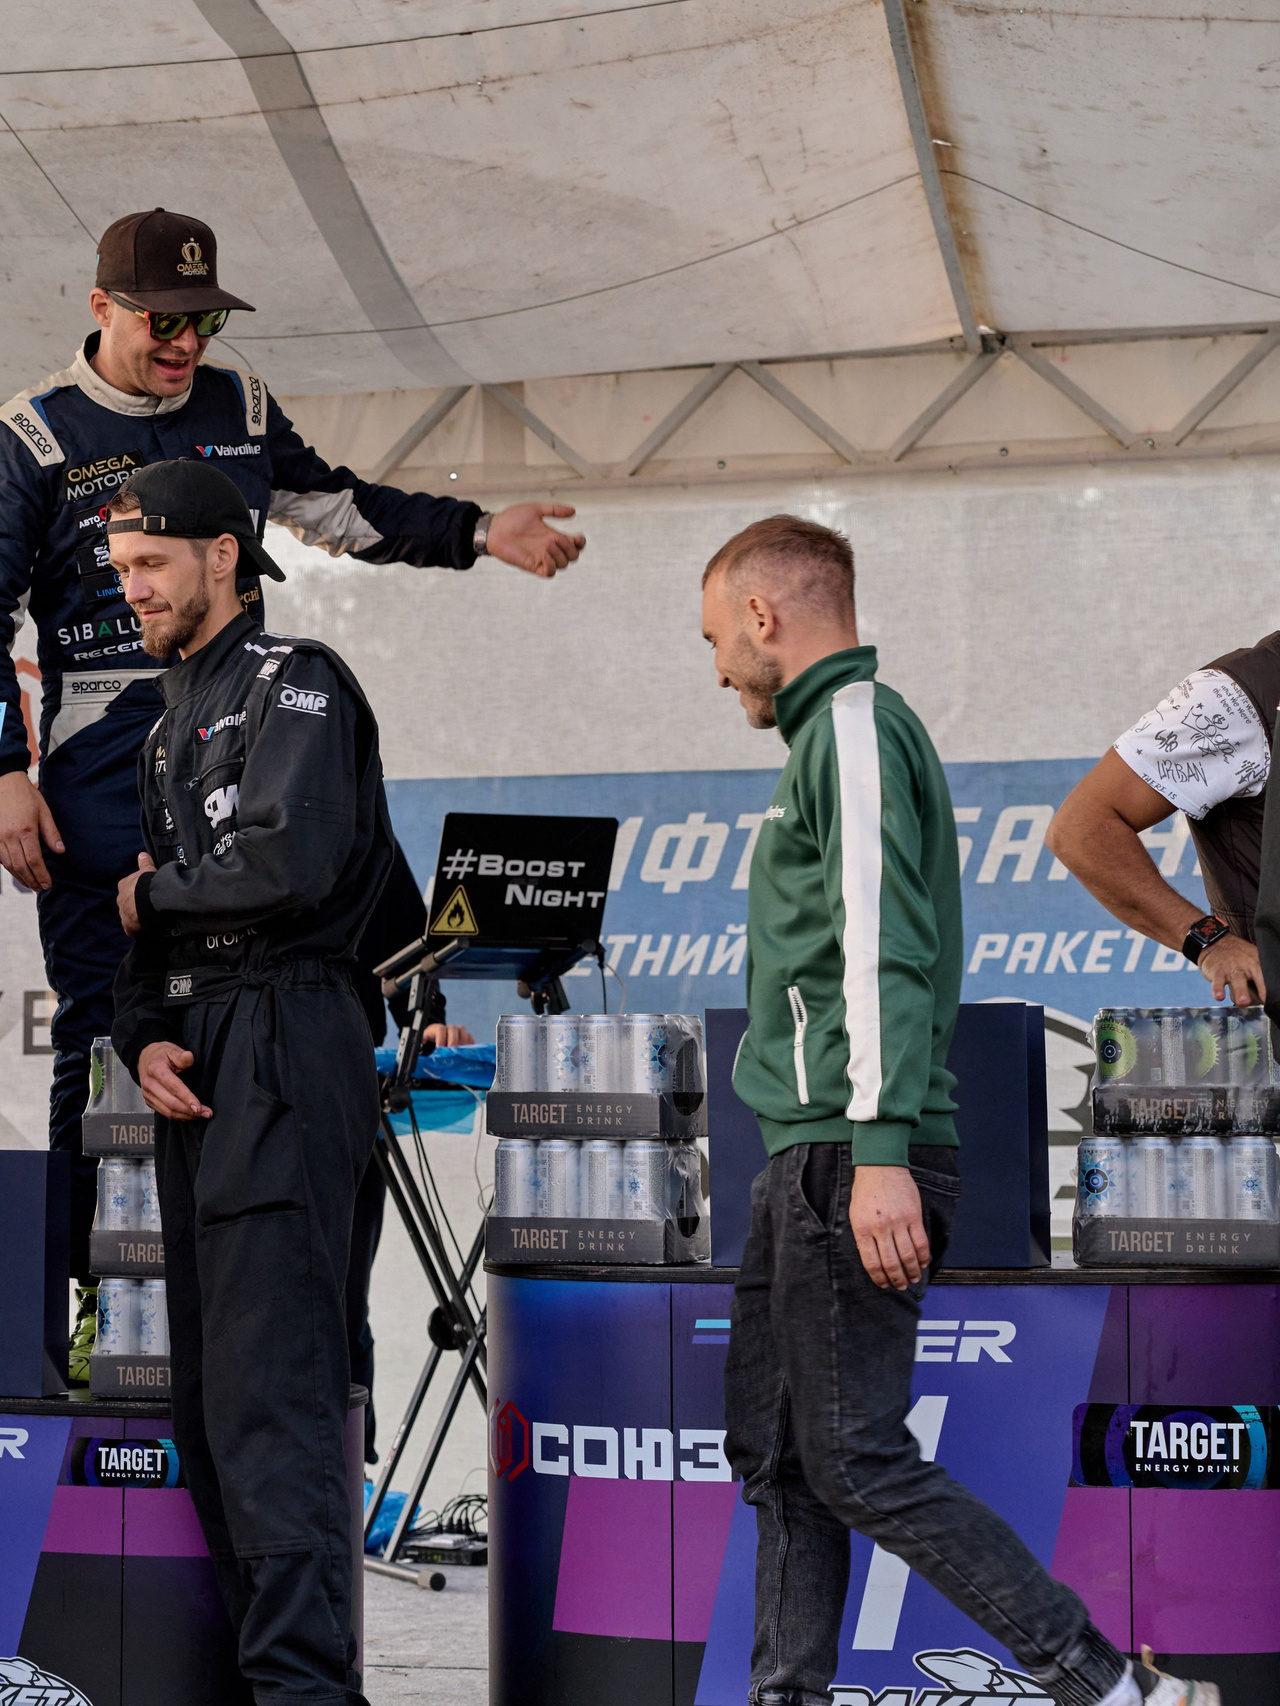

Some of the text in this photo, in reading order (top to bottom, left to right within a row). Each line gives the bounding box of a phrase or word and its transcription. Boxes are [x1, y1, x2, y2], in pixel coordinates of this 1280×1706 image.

[11, 412, 53, 456] sparco
[67, 454, 136, 482] OMEGA
[96, 586, 126, 598] LINKG
[57, 616, 143, 646] SIBALU
[260, 661, 279, 676] MP
[71, 680, 122, 695] sparco
[279, 687, 328, 712] OMP
[1157, 759, 1208, 787] URBAN
[1141, 772, 1178, 801] THERE IS
[169, 978, 193, 994] OMP
[511, 1103, 568, 1125] TARGET
[576, 1104, 633, 1114] ENERGY
[1127, 1097, 1197, 1121] TARGET
[576, 1116, 623, 1126] DRINK
[110, 1124, 155, 1145] TARGE
[510, 1228, 569, 1250] TARGET
[578, 1230, 636, 1240] ENERGY
[1108, 1230, 1175, 1253] TARGET
[1185, 1232, 1252, 1242] ENERGY
[118, 1242, 165, 1263] TARGE
[578, 1242, 626, 1251] DRINK
[1185, 1244, 1240, 1254] DRINK
[1130, 1421, 1246, 1461] TARGET
[98, 1446, 165, 1472] TARGET
[532, 1421, 733, 1483] СОЮЗ
[100, 1471, 162, 1480] ENERGY DRINK
[1135, 1463, 1240, 1474] ENERGY DRINK
